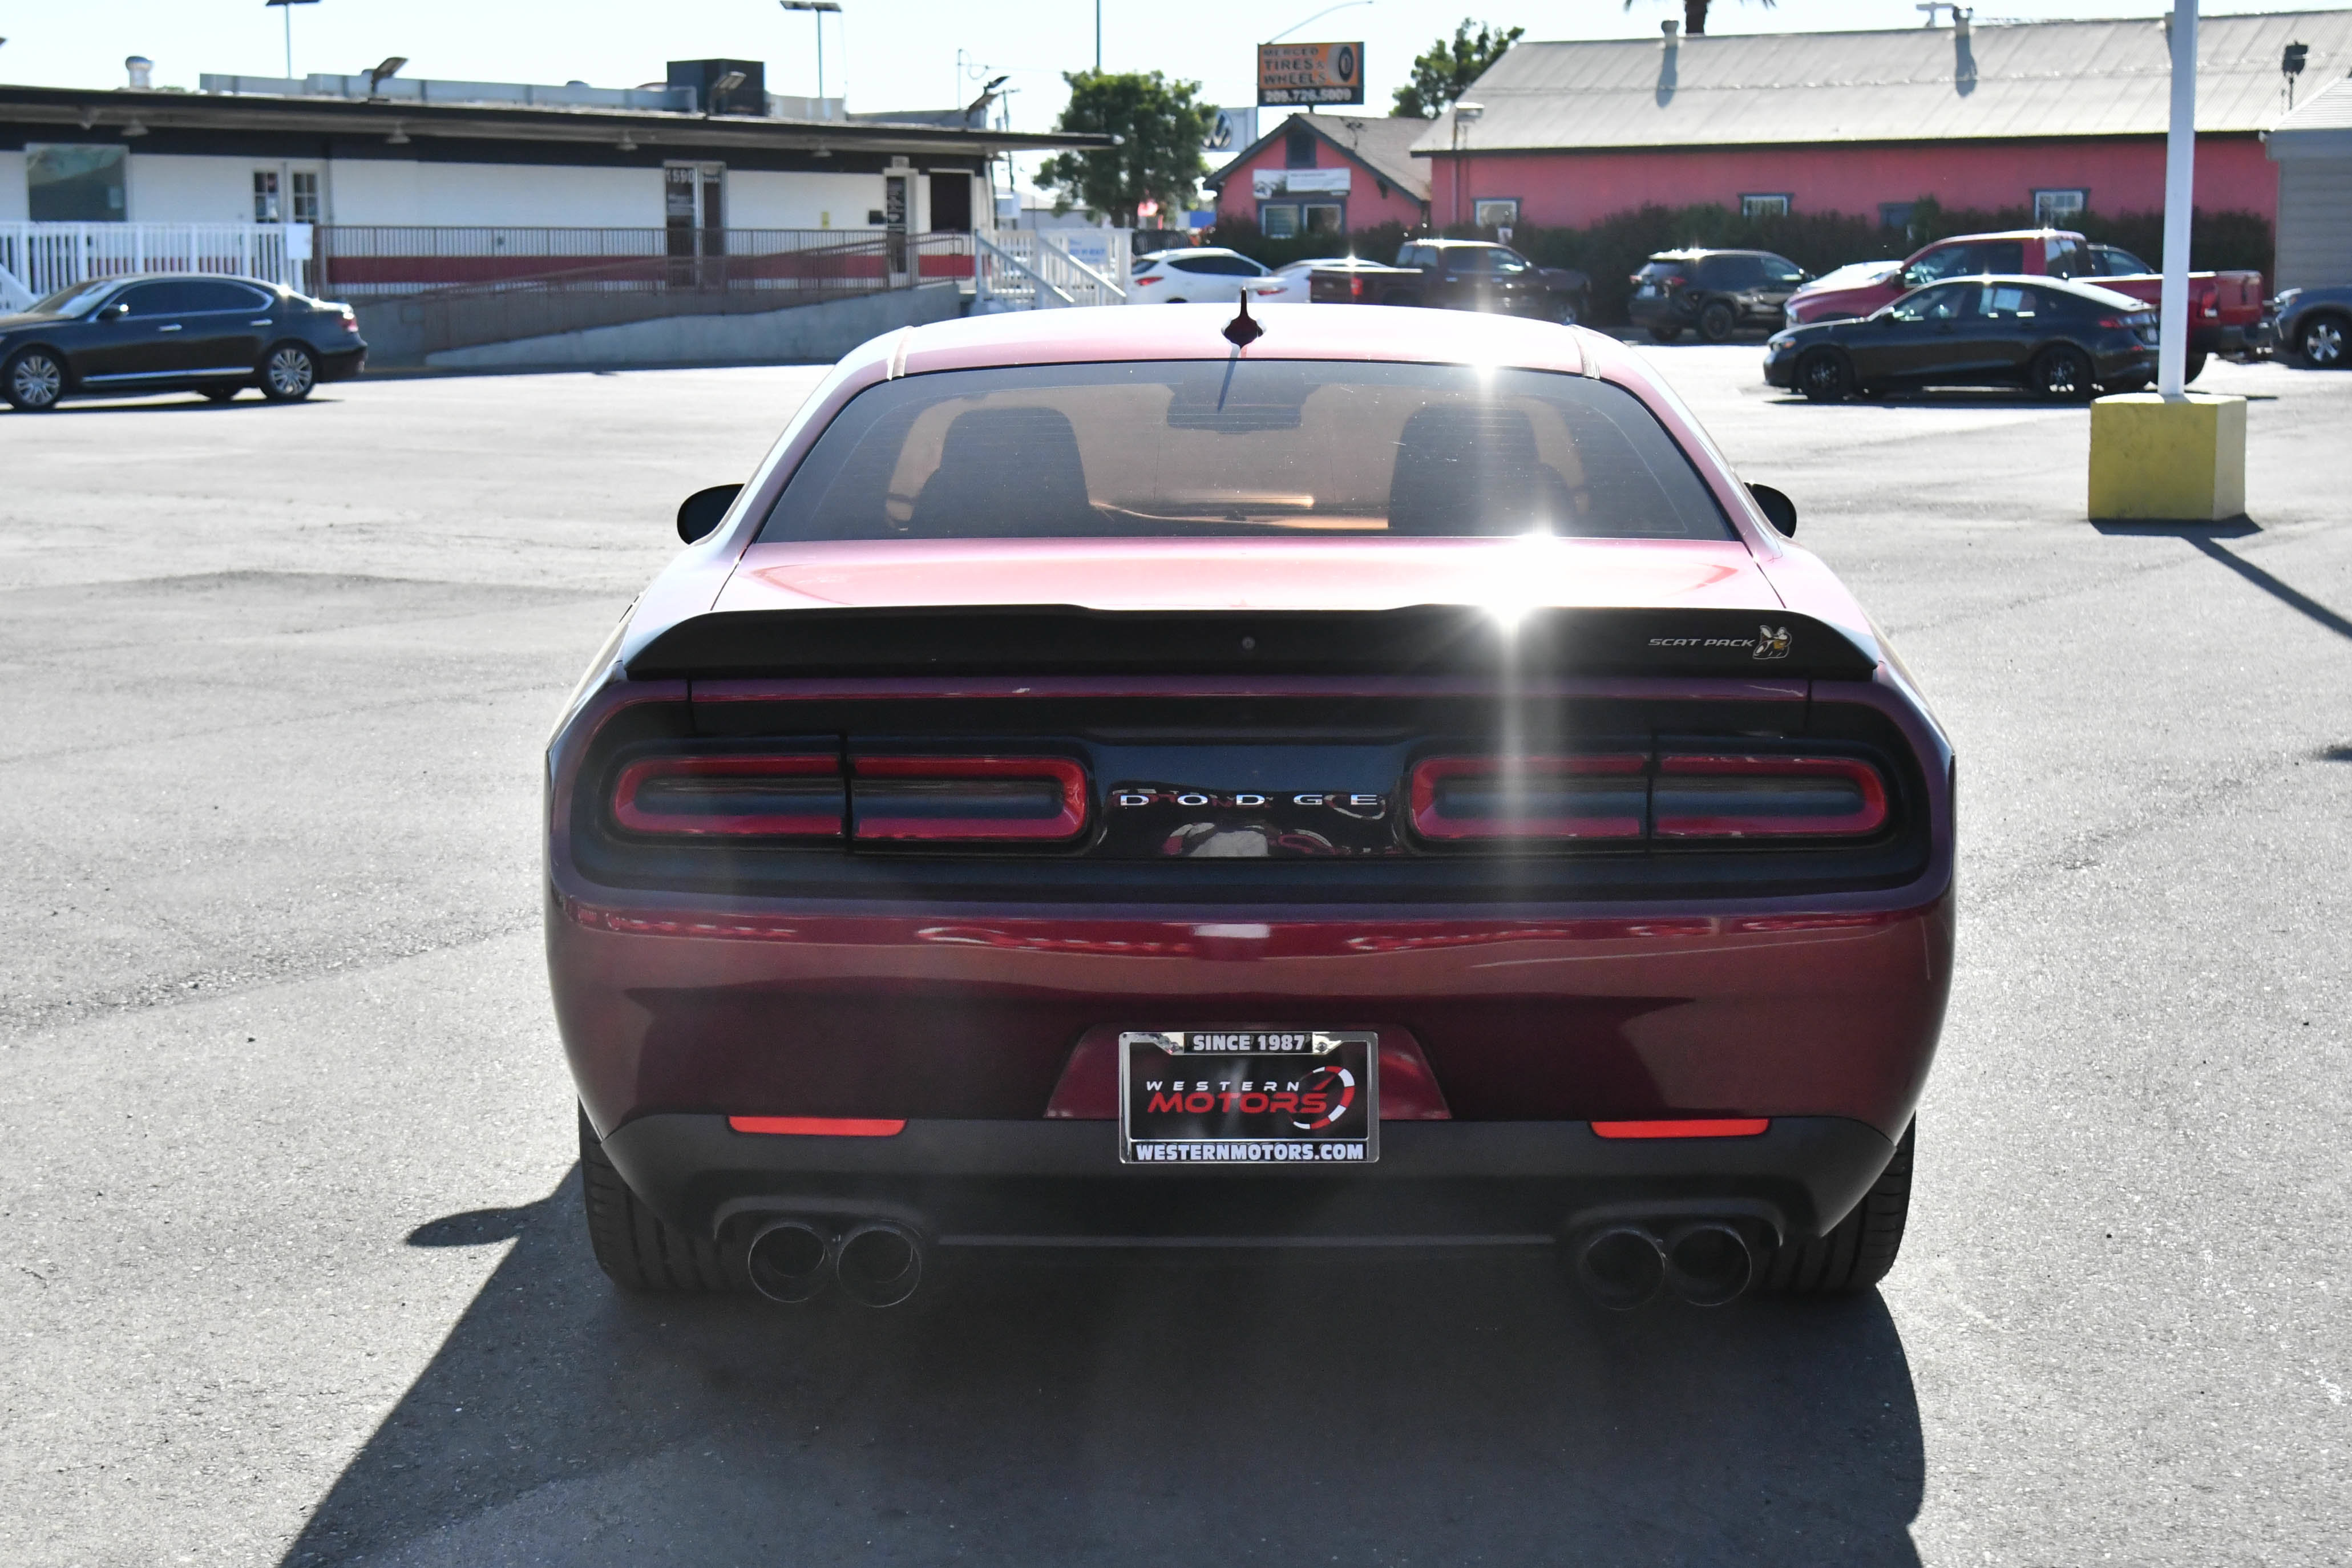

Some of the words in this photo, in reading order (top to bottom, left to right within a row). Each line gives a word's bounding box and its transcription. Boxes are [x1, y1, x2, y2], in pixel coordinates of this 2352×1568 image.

[1263, 47, 1318, 56] MERCED
[1264, 59, 1313, 71] TIRES
[1264, 72, 1327, 85] WHEELS
[1120, 794, 1378, 806] DODGE
[1193, 1034, 1250, 1050] SINCE
[1258, 1034, 1305, 1050] 1987
[1146, 1081, 1300, 1092] WESTERN
[1147, 1092, 1328, 1114] MOTORS
[1136, 1143, 1363, 1161] WESTERNMOTORS.COM
